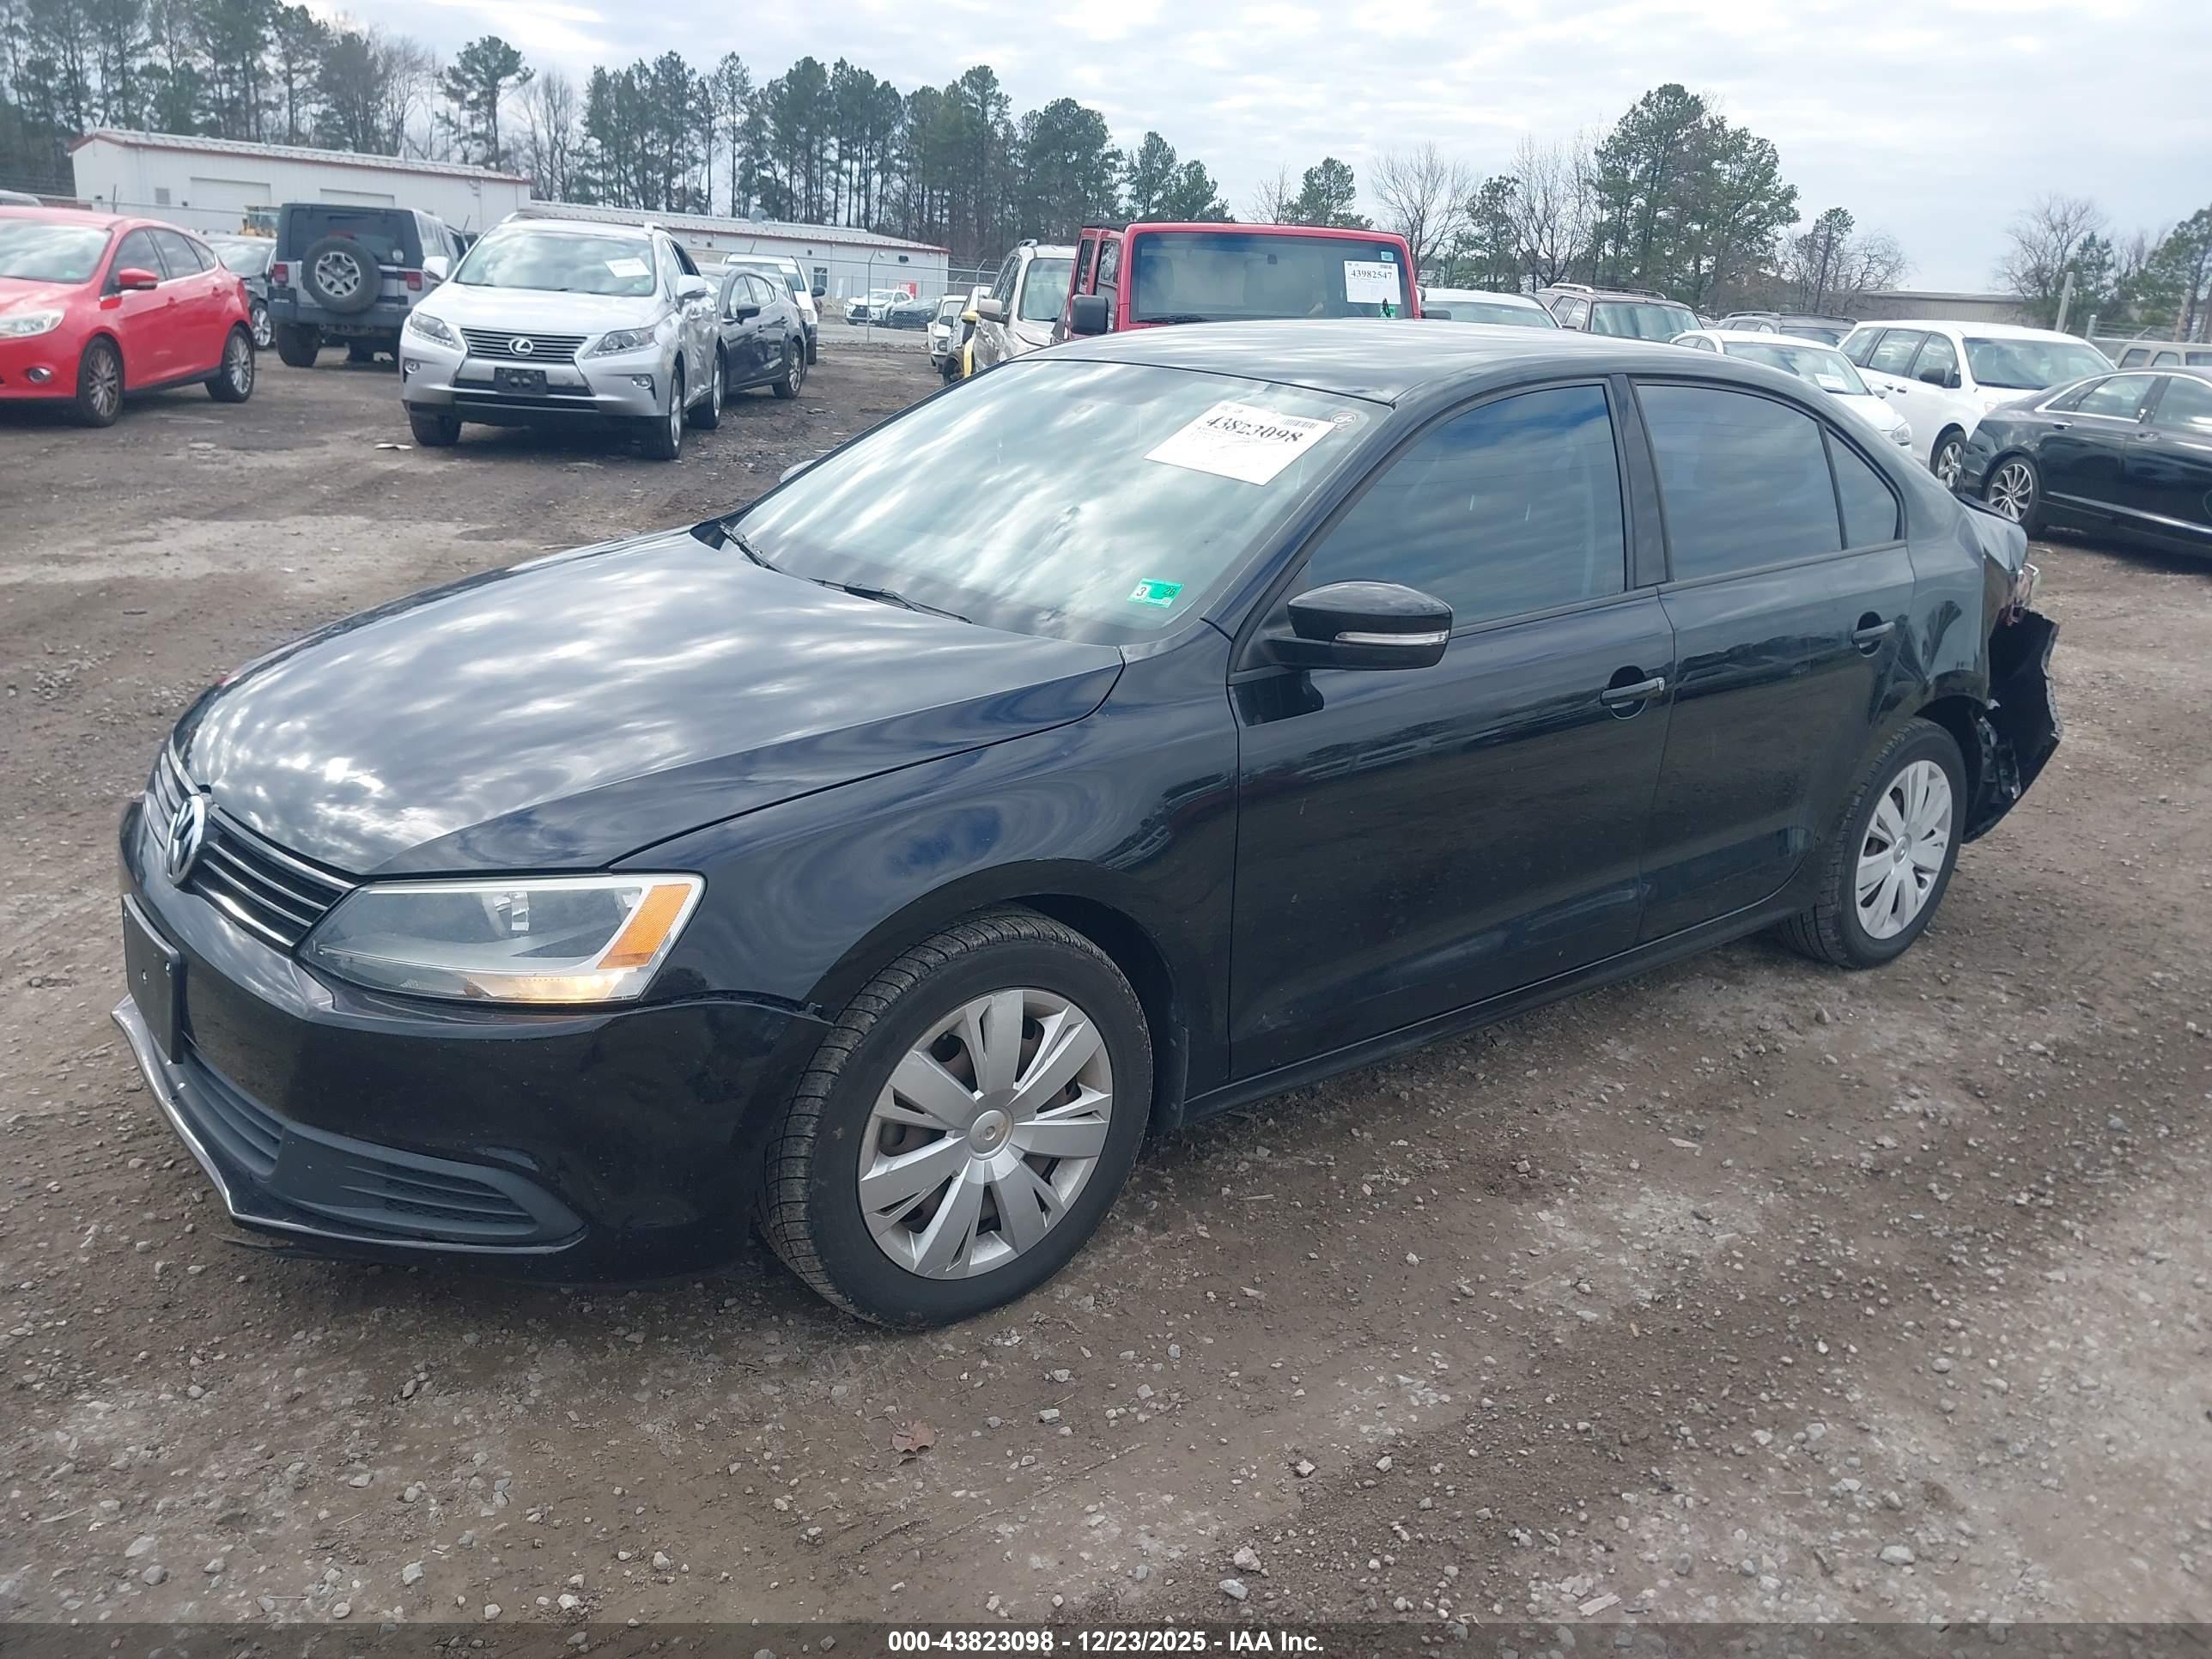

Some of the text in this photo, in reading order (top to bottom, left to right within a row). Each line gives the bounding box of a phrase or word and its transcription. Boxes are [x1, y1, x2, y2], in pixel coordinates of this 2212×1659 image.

[1351, 269, 1393, 280] 43982547
[1206, 415, 1304, 443] 43823098
[1136, 586, 1147, 597] 3
